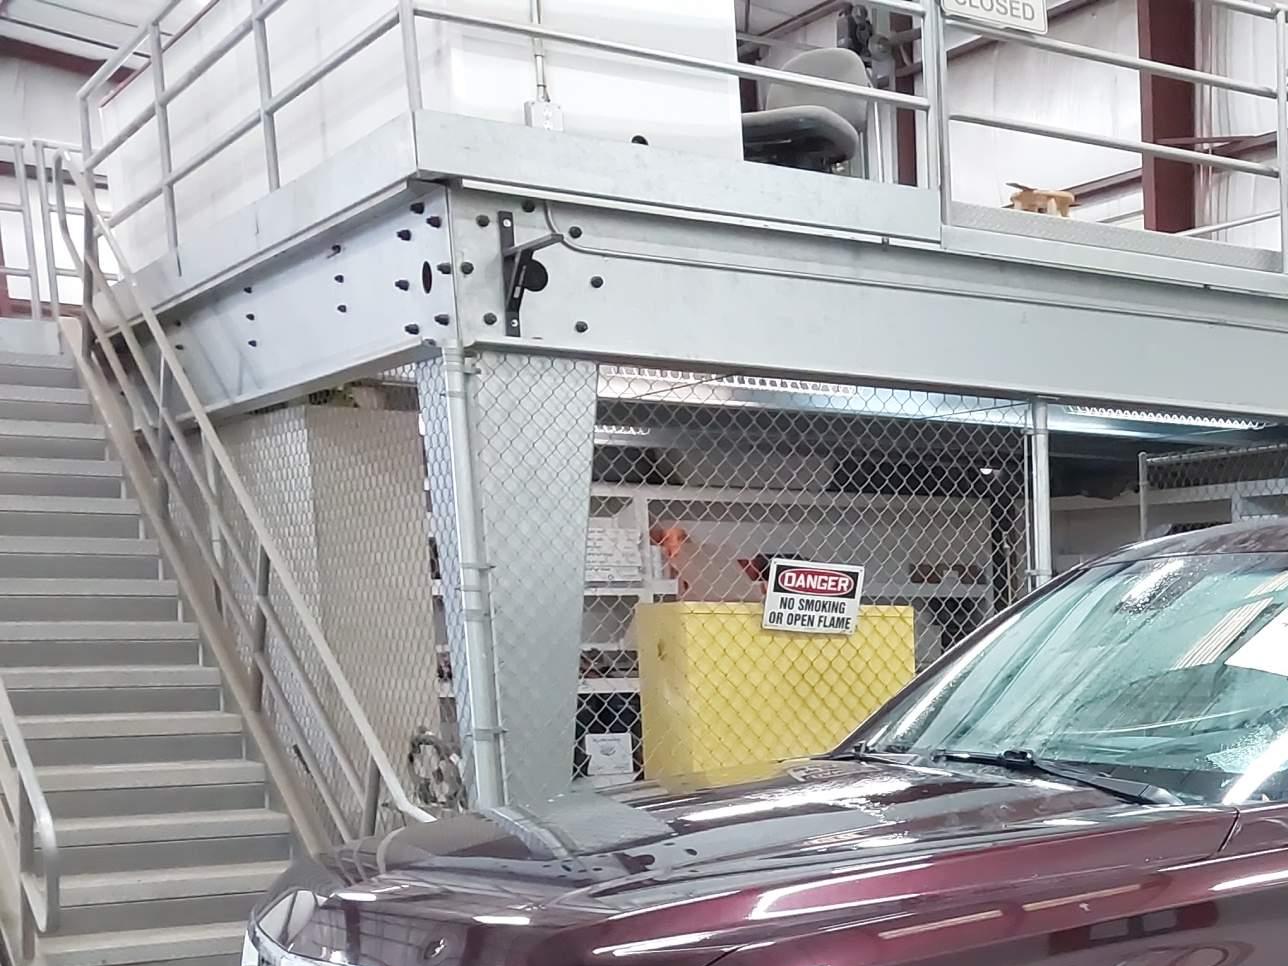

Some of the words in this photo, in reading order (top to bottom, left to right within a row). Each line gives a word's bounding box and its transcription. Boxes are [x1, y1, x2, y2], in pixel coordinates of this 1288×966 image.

[783, 572, 850, 592] DANGER
[780, 597, 795, 610] NO
[798, 598, 846, 614] SMOKING
[768, 611, 784, 625] OR
[786, 613, 815, 627] OPEN
[817, 615, 852, 630] FLAME
